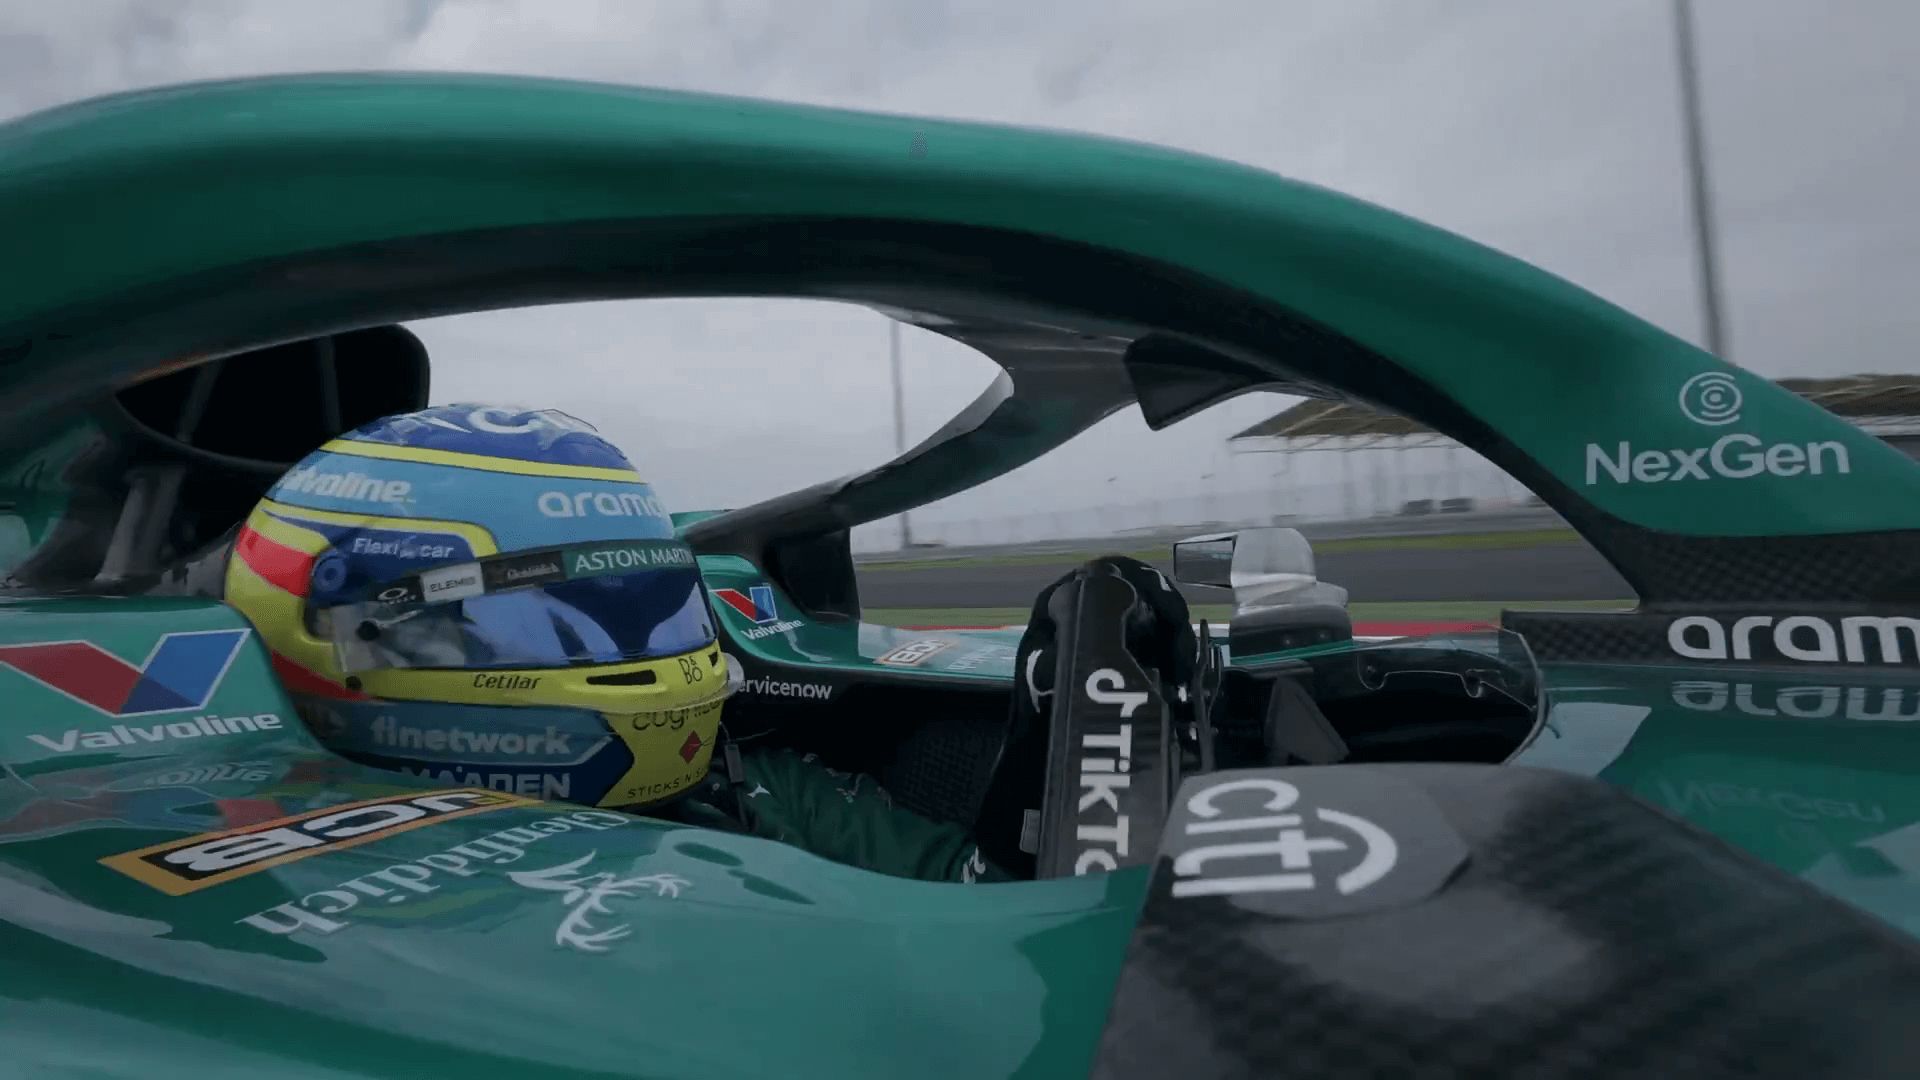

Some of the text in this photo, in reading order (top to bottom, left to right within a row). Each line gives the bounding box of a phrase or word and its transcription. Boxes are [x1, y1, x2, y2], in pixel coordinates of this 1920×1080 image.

[1585, 434, 1850, 485] NexGen
[420, 543, 455, 558] car
[575, 549, 647, 574] ASTON
[740, 619, 805, 640] Valvoline
[473, 673, 542, 690] Cetilar
[739, 675, 833, 700] ervicenow
[28, 710, 283, 752] Valvoline
[627, 777, 681, 799] STICKS
[163, 792, 484, 873] JCB
[1171, 778, 1349, 897] citi
[234, 810, 631, 936] Glenfiddich
